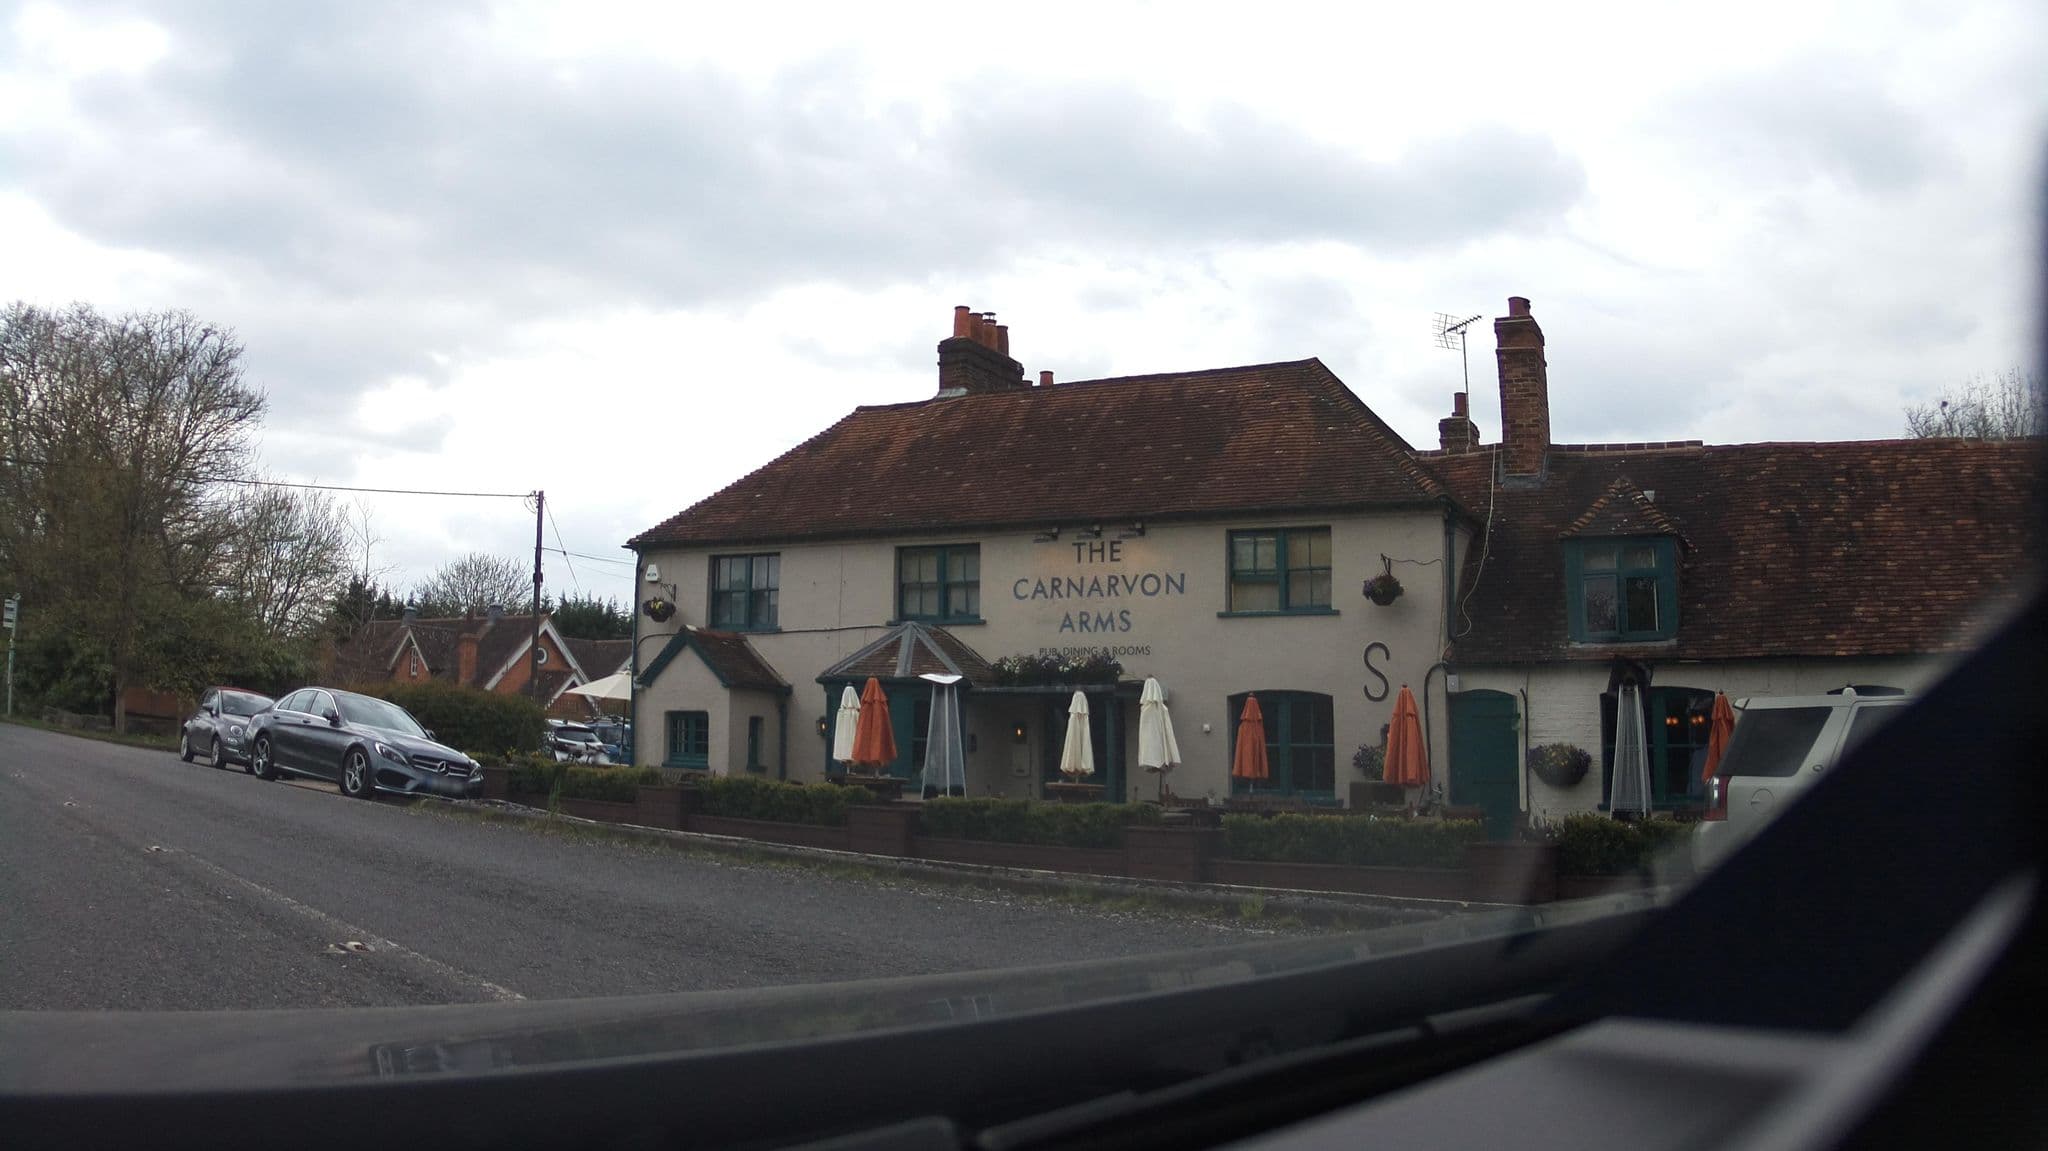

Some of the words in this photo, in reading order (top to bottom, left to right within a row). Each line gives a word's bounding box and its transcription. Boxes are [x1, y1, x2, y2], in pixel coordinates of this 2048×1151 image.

[1072, 540, 1122, 564] THE
[1014, 573, 1185, 600] CARNARVON
[1059, 610, 1132, 633] ARMS
[1062, 646, 1098, 656] DINING
[1112, 645, 1151, 656] ROOMS
